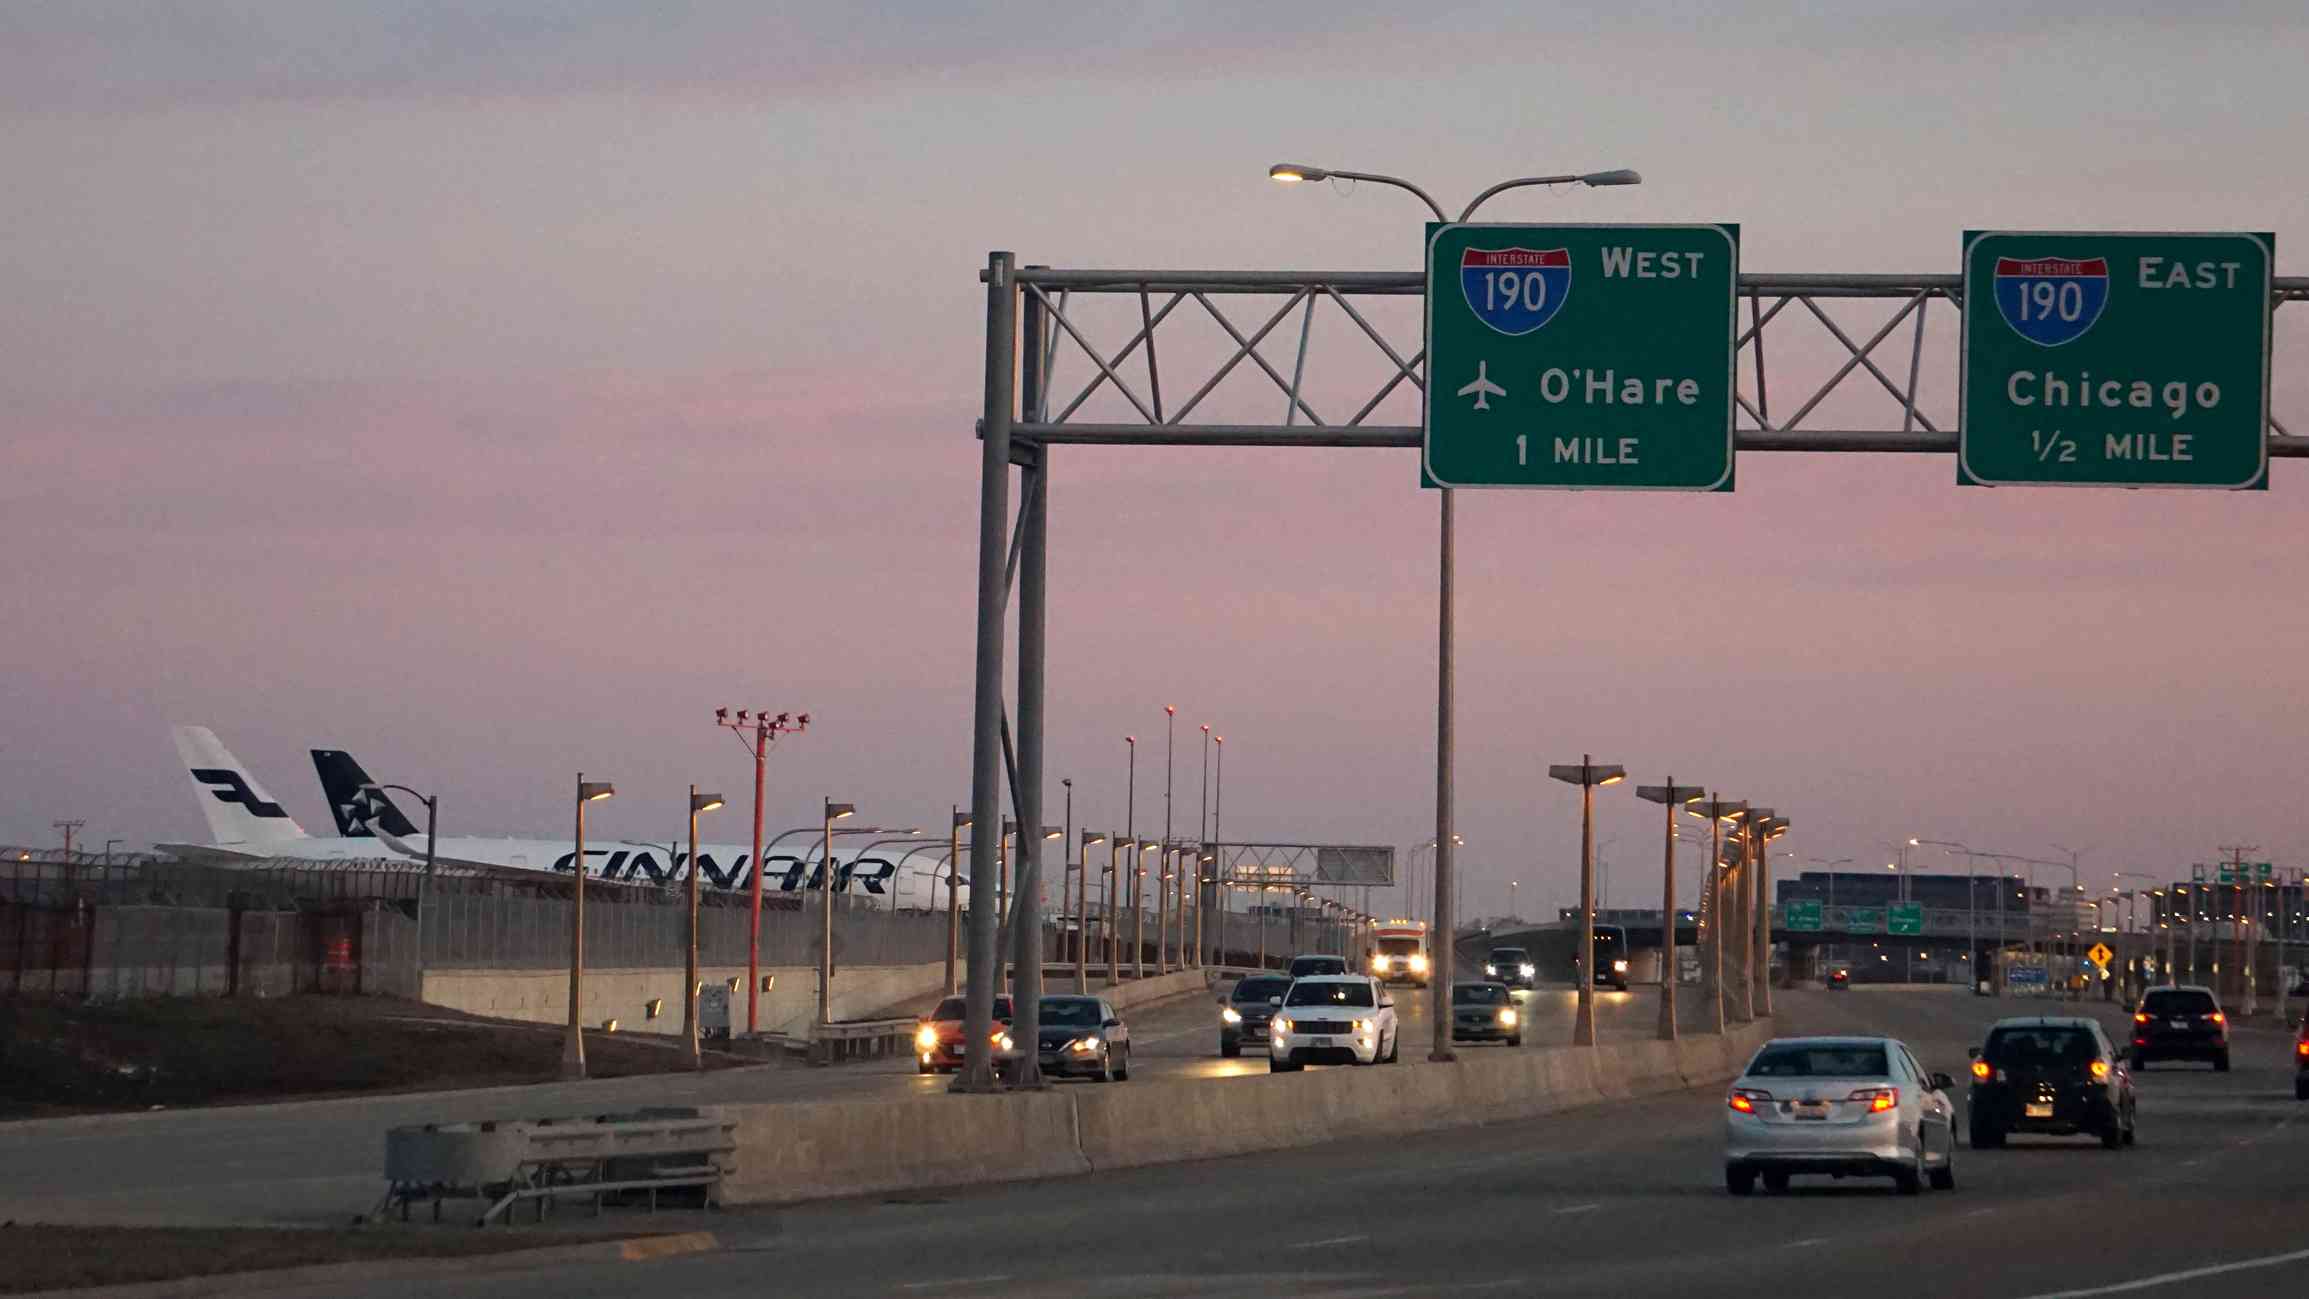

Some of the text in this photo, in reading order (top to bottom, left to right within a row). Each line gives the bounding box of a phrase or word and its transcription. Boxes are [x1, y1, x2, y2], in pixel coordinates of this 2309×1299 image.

[1486, 253, 1545, 266] INTERSTATE
[1600, 246, 1704, 279] WEST
[2020, 262, 2082, 275] INTERSTATE
[2138, 256, 2241, 289] EAST
[1484, 271, 1547, 312] 190
[2018, 281, 2084, 322] 190
[1539, 367, 1700, 406] O'Hare
[2006, 369, 2221, 420] Chicago
[1515, 434, 1640, 466] 1 MILE
[2104, 433, 2194, 461] MILE
[554, 850, 896, 894] FINNAIR
